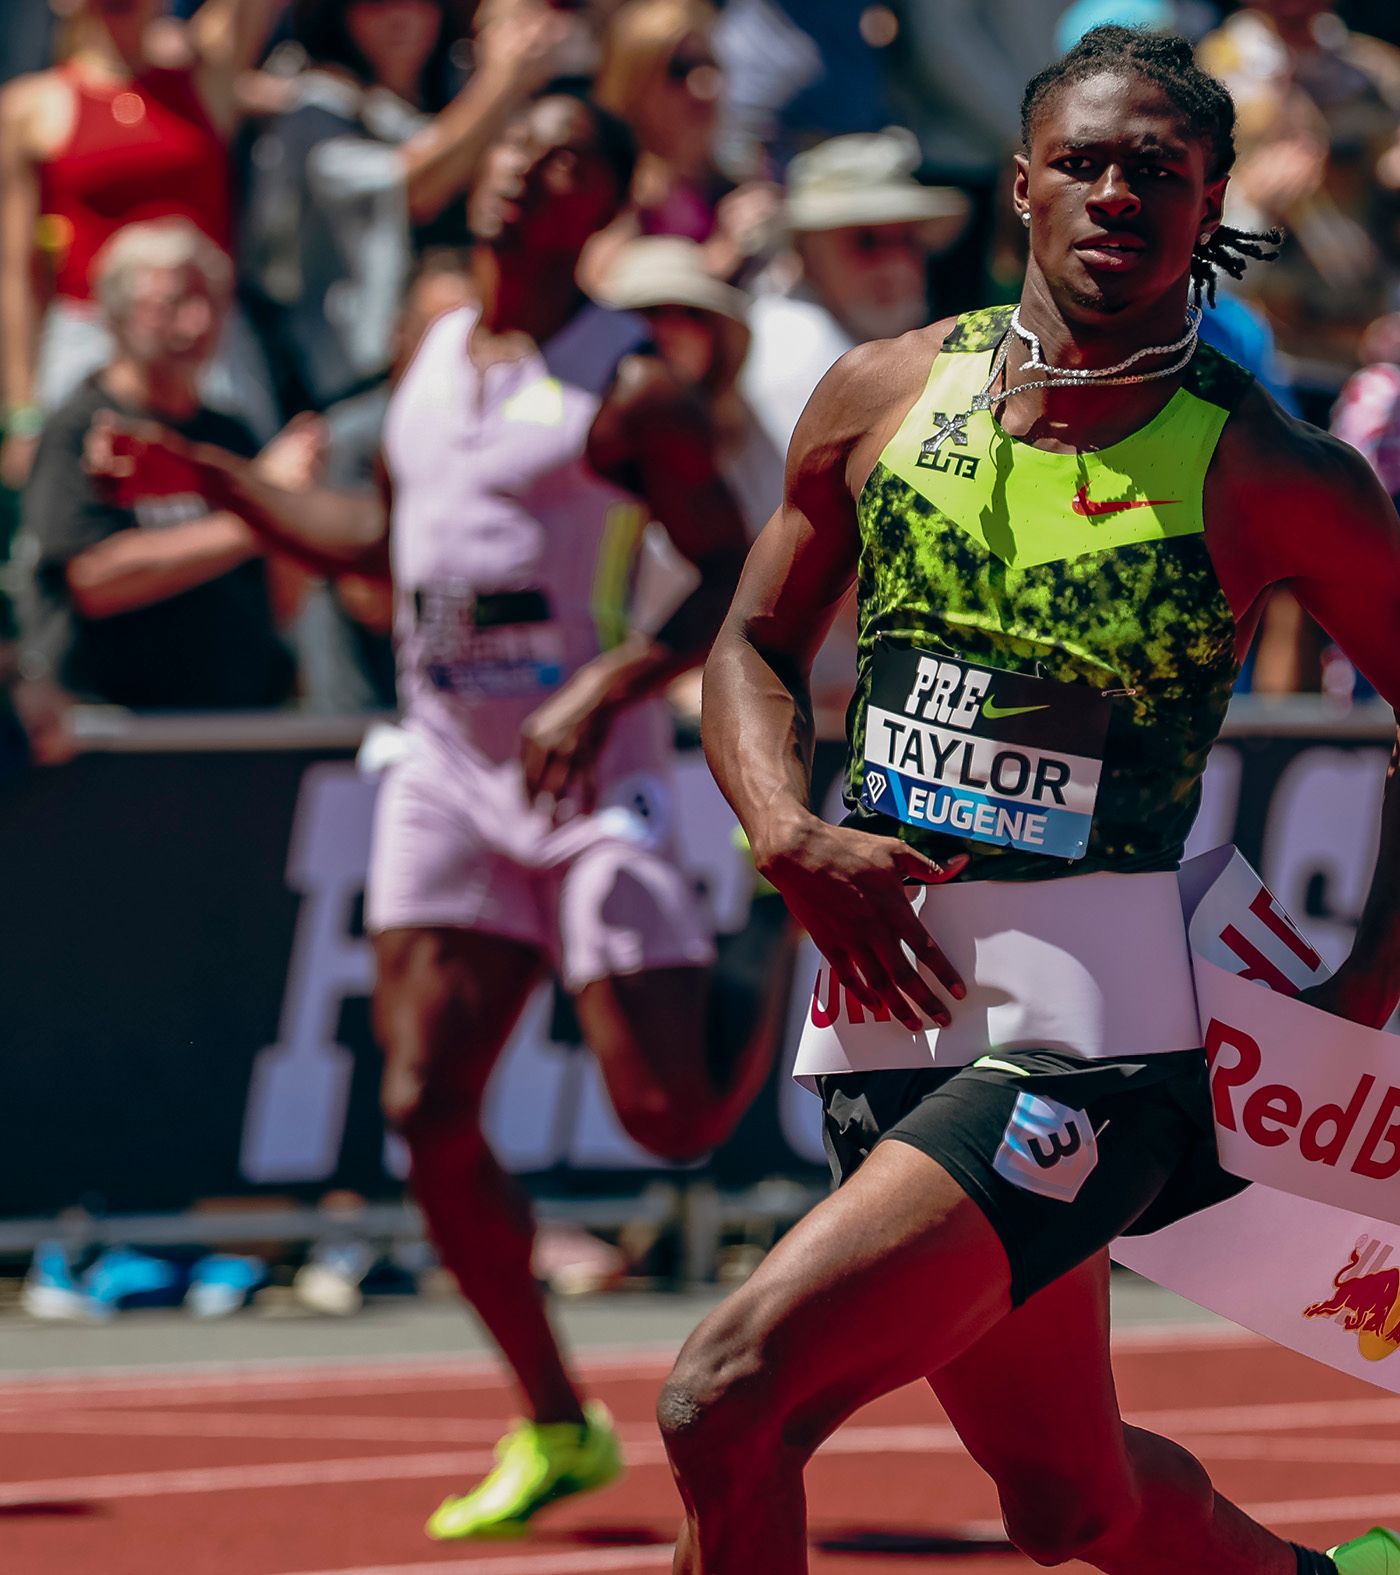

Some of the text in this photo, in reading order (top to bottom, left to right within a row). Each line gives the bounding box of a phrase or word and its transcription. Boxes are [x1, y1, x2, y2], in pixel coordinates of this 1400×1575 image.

[904, 655, 992, 729] PRE
[883, 719, 1071, 805] TAYLOR
[908, 786, 1048, 845] EUGENE
[1028, 1121, 1080, 1169] 3
